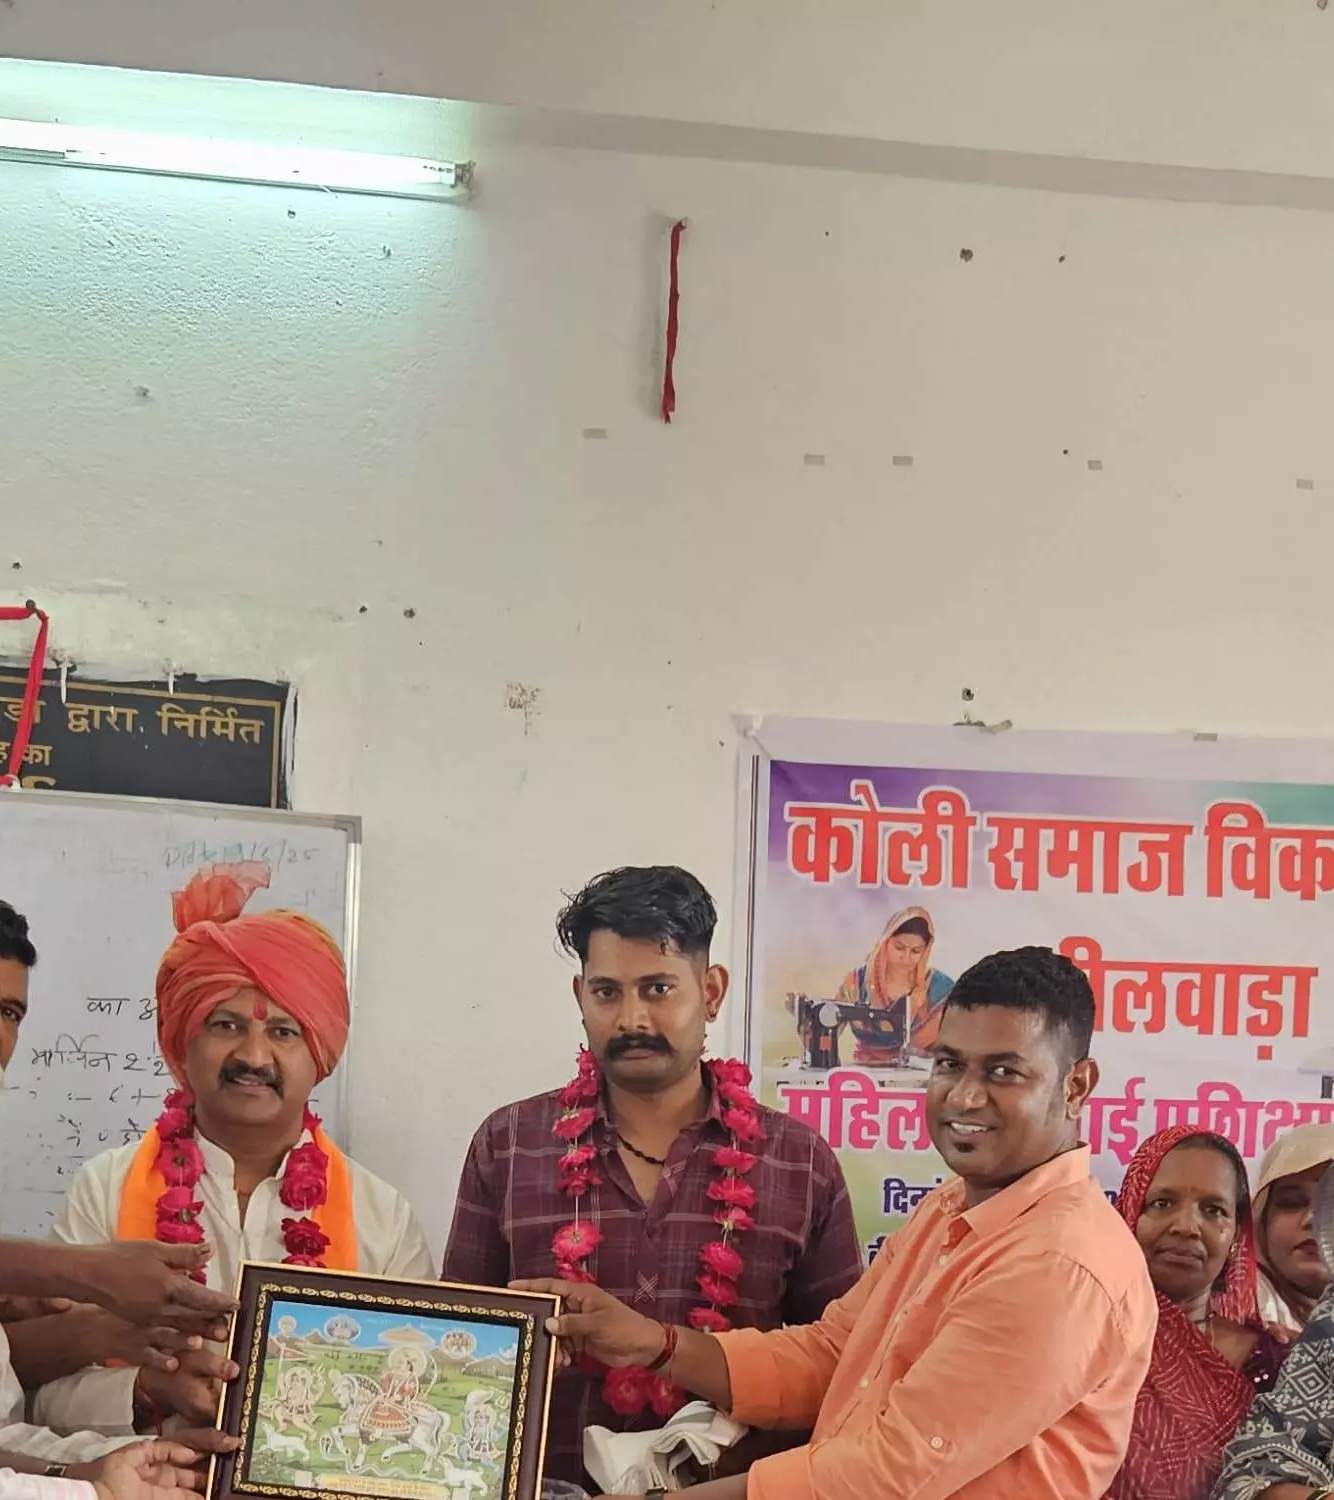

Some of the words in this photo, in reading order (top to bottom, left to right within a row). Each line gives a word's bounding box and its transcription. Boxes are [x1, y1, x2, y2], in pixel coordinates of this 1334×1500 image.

[65, 702, 140, 733] द्वारा
[156, 702, 266, 744] निर्मित
[786, 782, 978, 889] कोली
[985, 815, 1195, 897] समाज
[1058, 935, 1319, 1061] ीलवाड़ा
[781, 1070, 934, 1150] महिल
